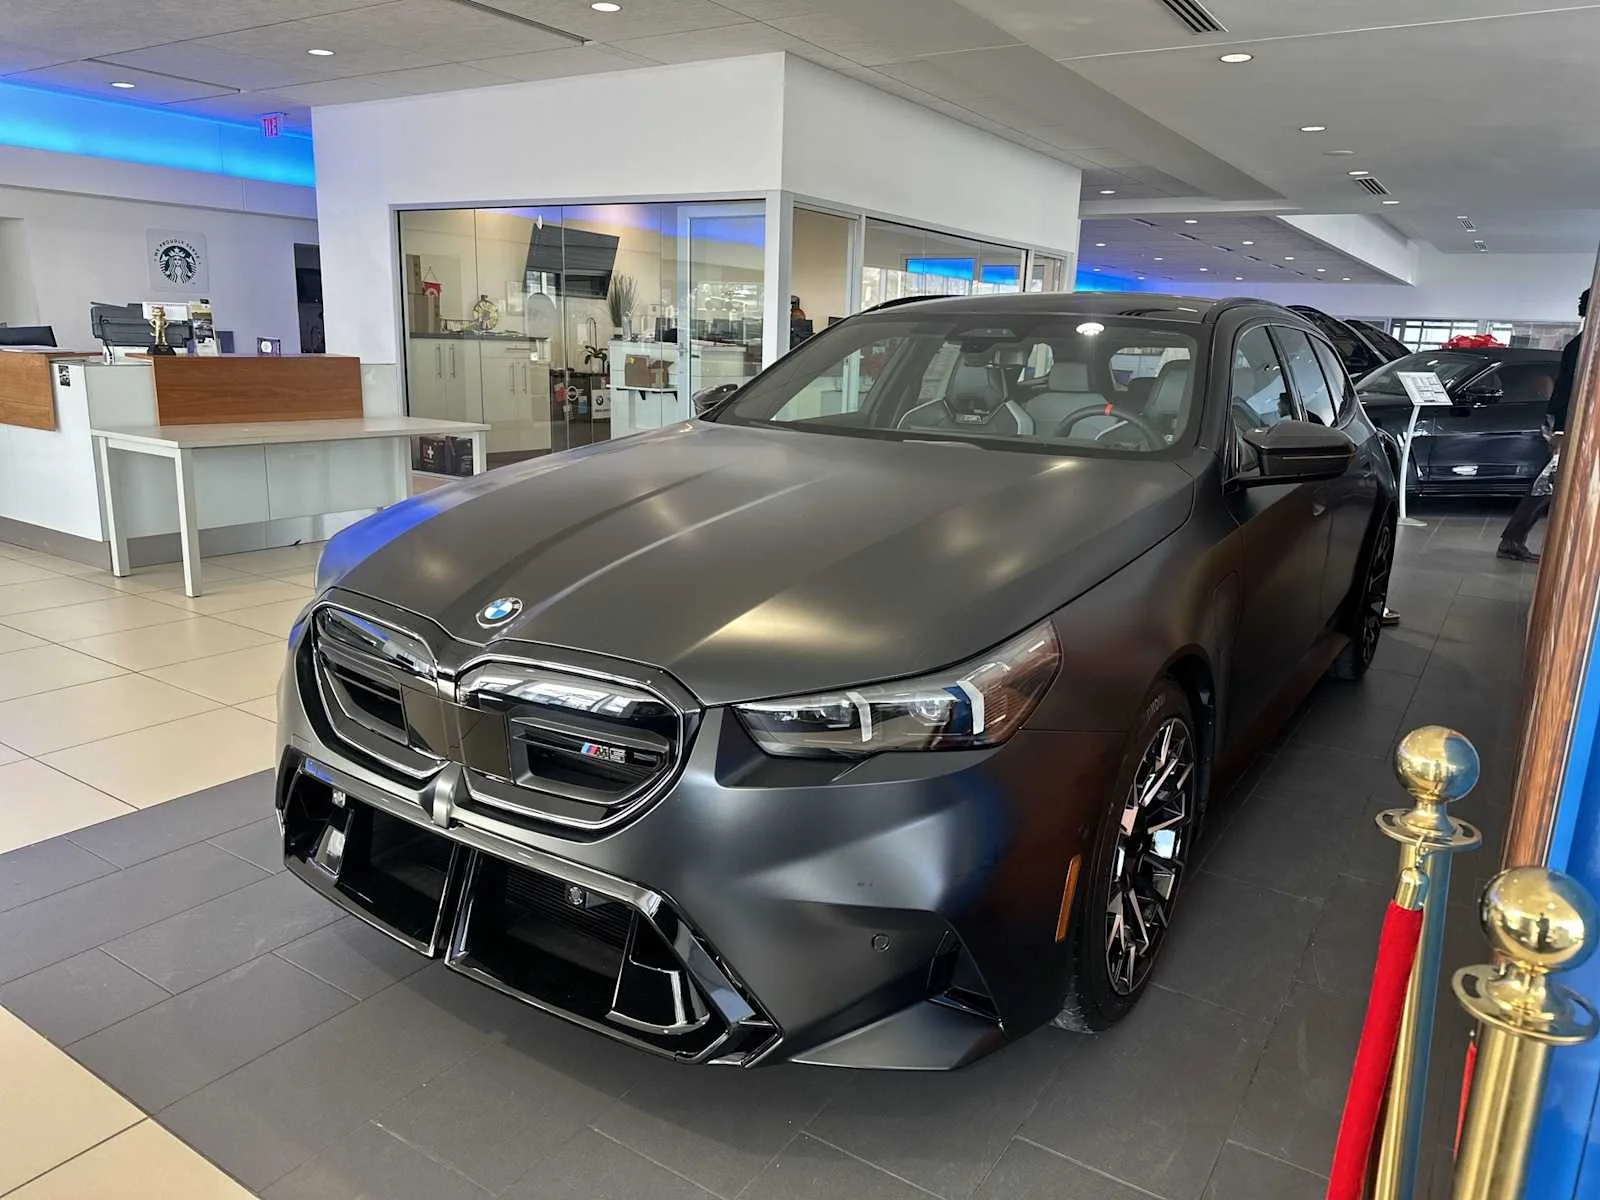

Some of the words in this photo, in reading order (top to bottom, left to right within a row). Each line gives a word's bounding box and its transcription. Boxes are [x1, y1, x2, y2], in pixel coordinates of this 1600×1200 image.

[159, 238, 185, 248] PROUDLY
[186, 243, 200, 259] SERVE
[588, 744, 626, 763] M5
